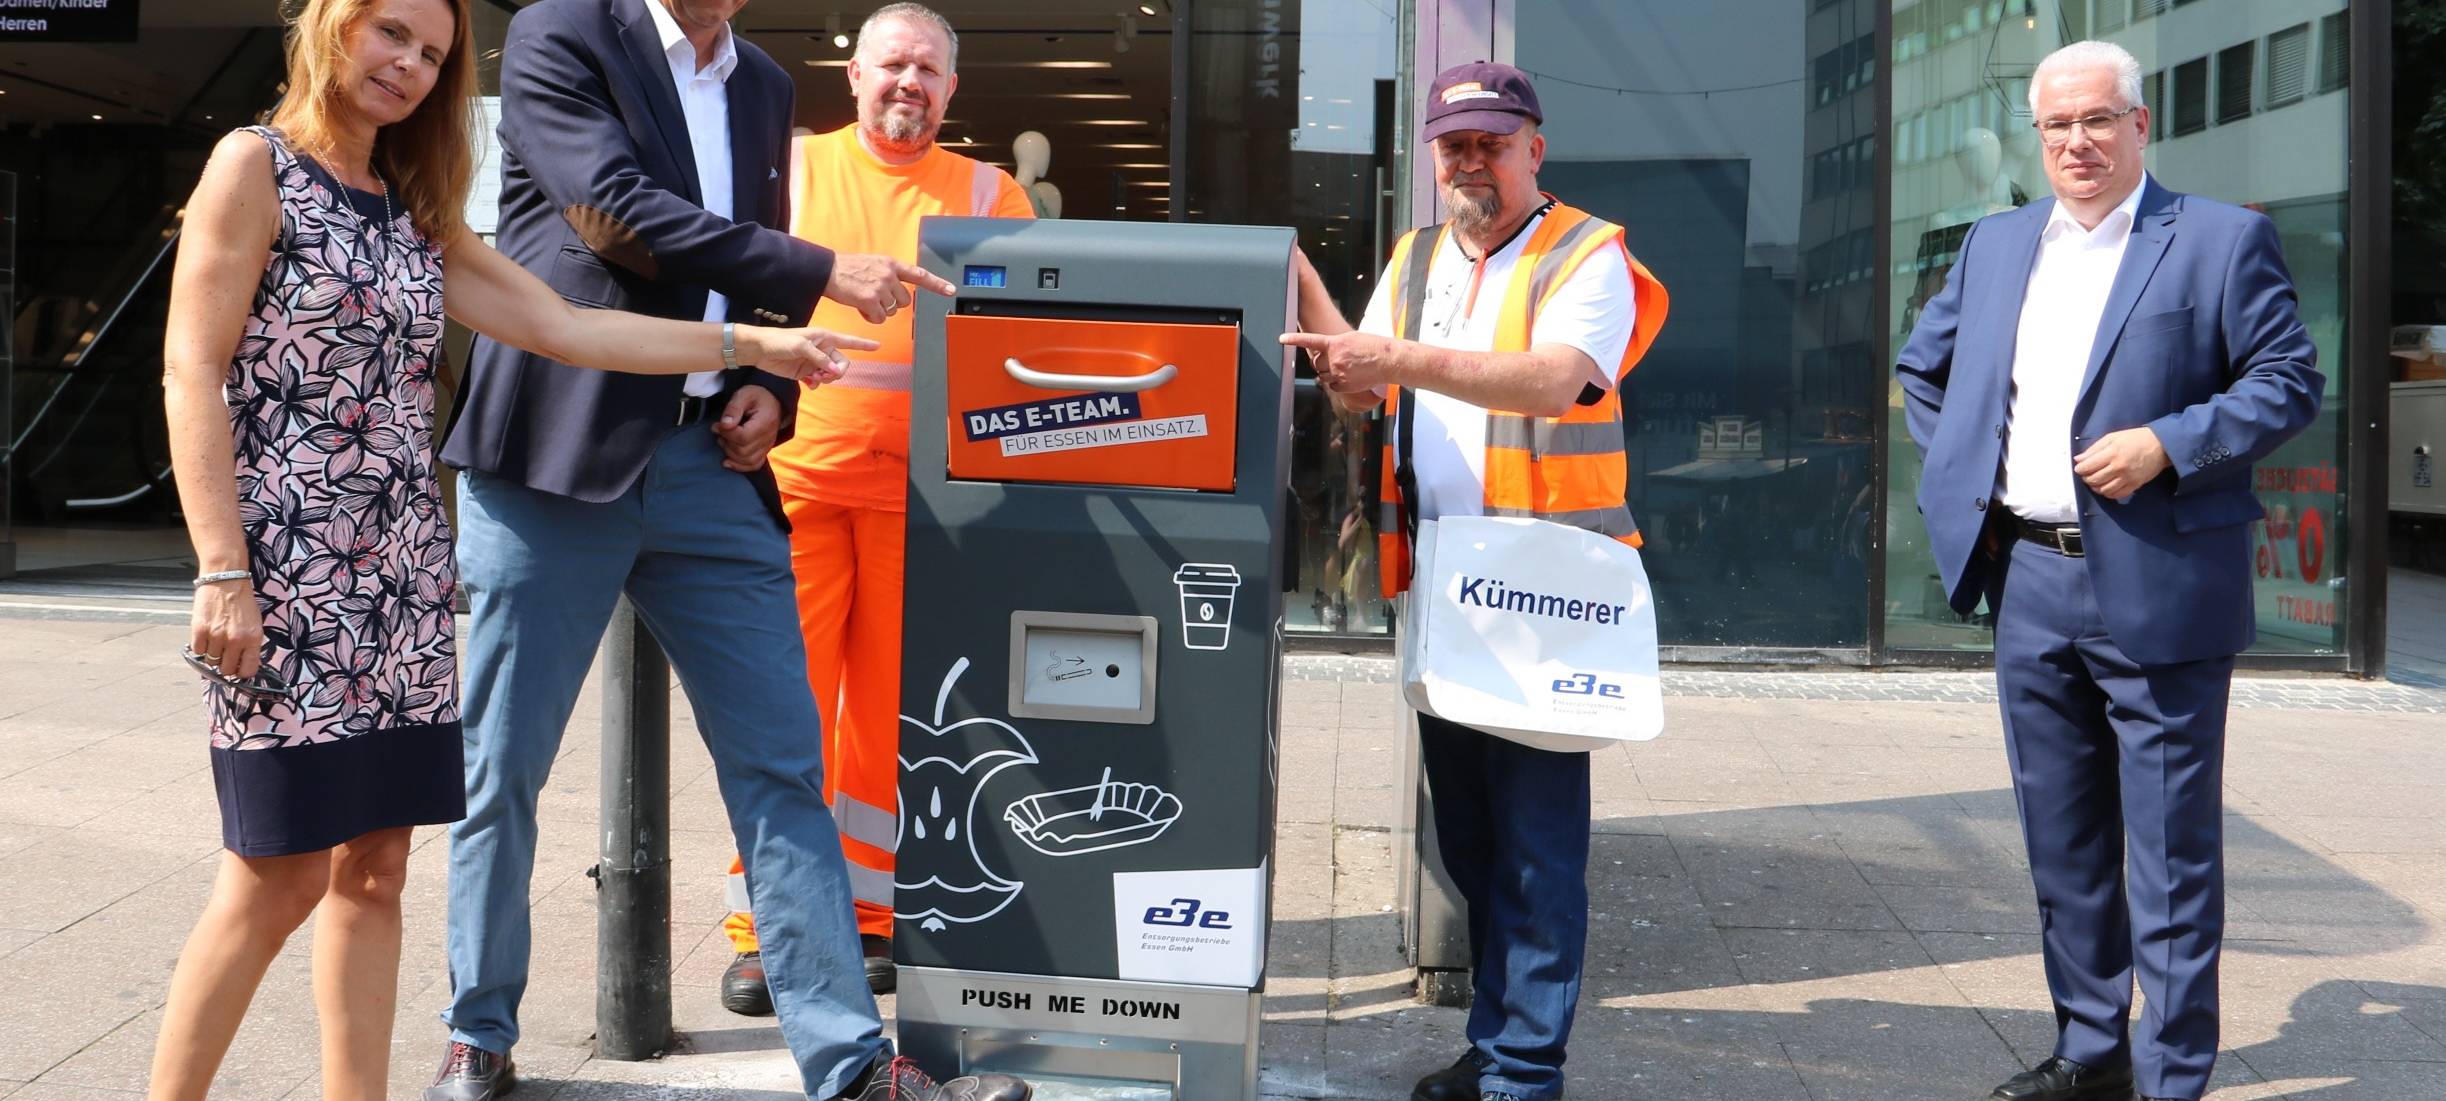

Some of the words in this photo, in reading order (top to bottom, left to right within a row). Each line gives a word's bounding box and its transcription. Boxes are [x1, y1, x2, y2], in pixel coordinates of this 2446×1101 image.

[969, 410, 1020, 435] DAS
[1025, 396, 1130, 428] E-TEAM.
[1005, 434, 1039, 452] FÜR
[1044, 430, 1098, 449] ESSEN
[1103, 426, 1121, 442] IM
[1128, 419, 1201, 439] EINSATZ.
[1459, 576, 1626, 625] Kümmerer
[1552, 673, 1625, 699] e3e
[1143, 898, 1233, 929] e3e
[1140, 942, 1166, 951] Essen
[1168, 944, 1194, 953] GmbH
[1141, 932, 1231, 945] Entsorgungsbetriebe
[962, 989, 1032, 1010] PUSH
[1048, 995, 1086, 1014] ME
[1102, 998, 1180, 1020] DOWN
